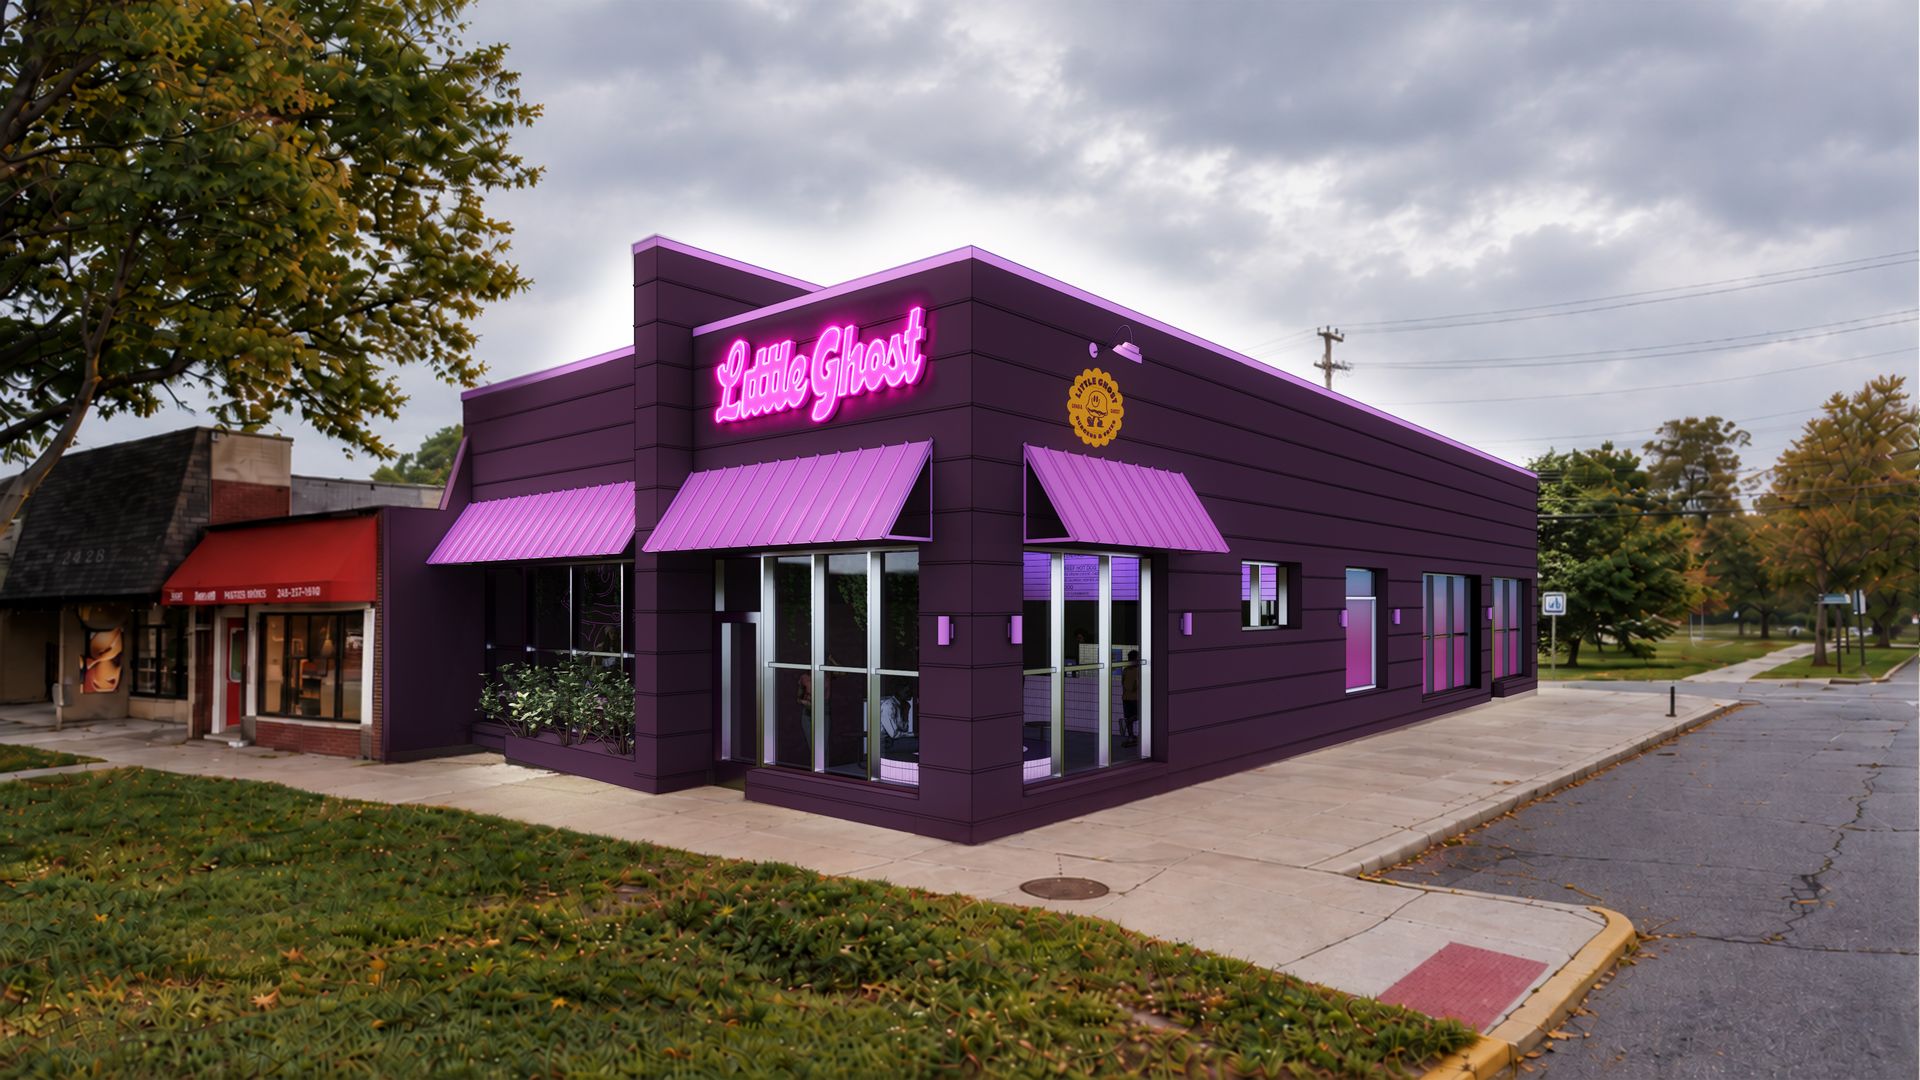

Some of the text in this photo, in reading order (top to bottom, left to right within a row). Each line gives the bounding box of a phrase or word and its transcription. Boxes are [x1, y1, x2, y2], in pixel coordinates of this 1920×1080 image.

[715, 307, 928, 424] Little Ghost
[1075, 377, 1118, 403] LITTLE GHOST
